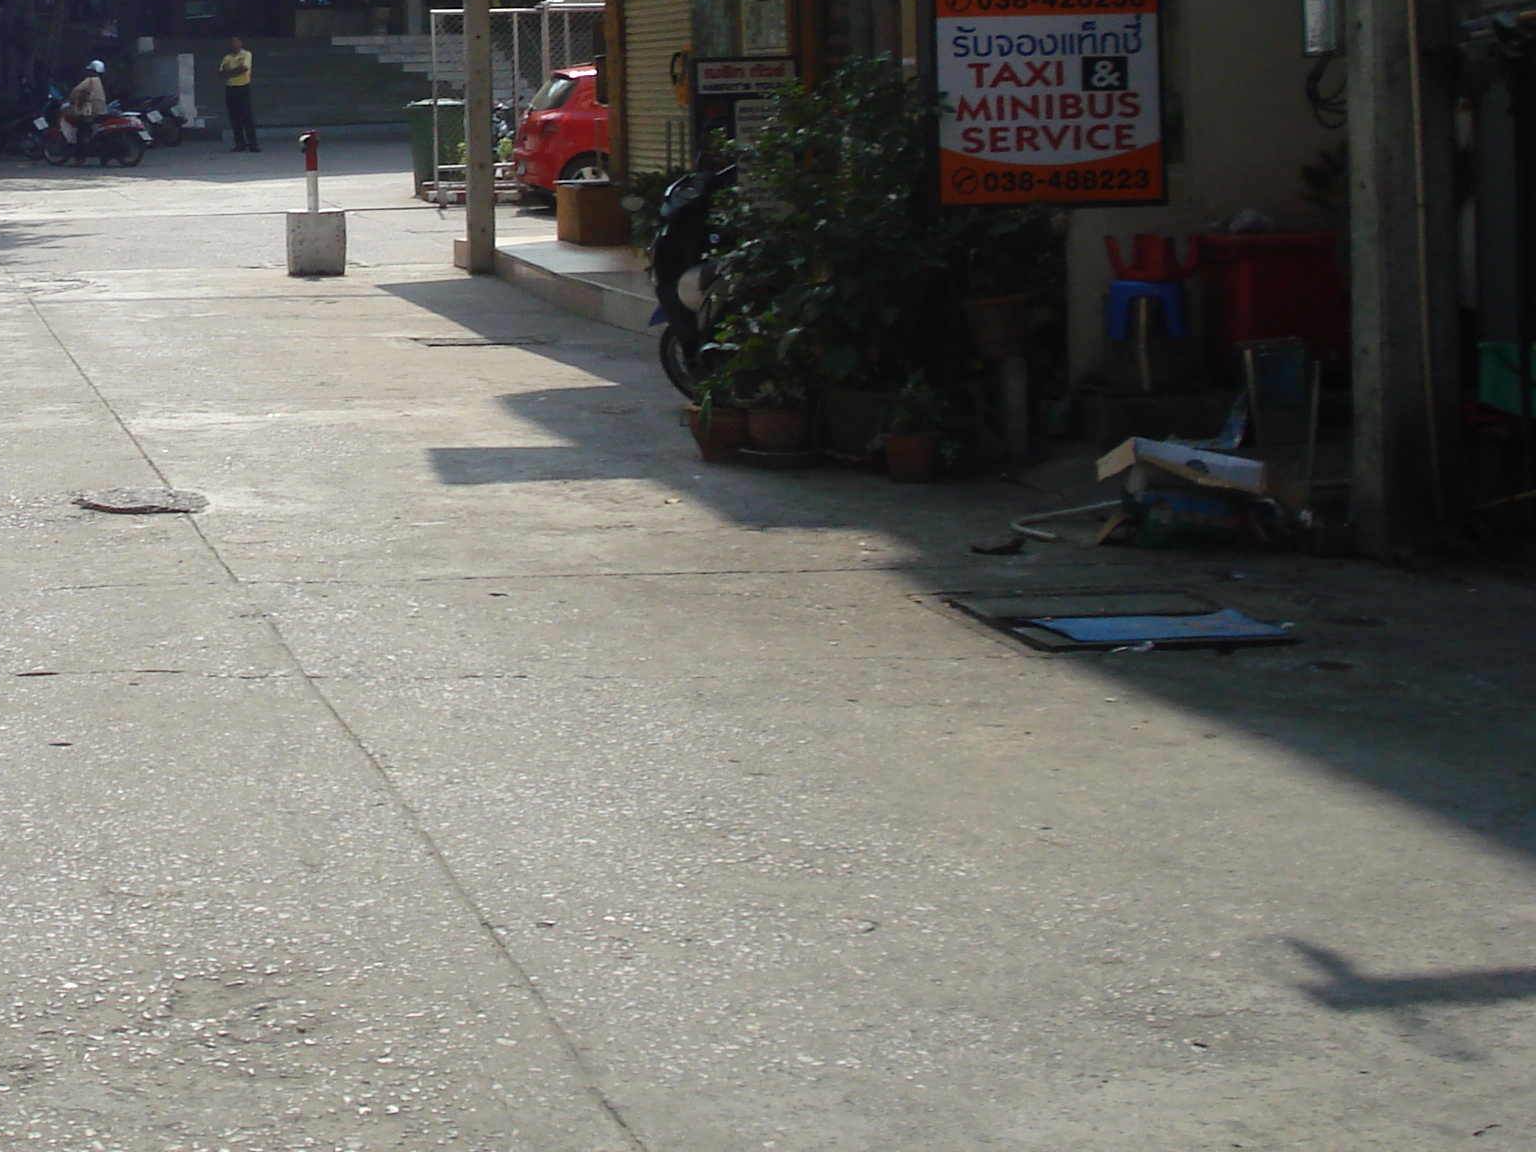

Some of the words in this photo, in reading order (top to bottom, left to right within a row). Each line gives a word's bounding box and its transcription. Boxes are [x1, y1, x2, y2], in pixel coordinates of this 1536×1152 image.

[967, 61, 1064, 90] TAXI
[1090, 59, 1121, 88] &
[955, 91, 1141, 123] MINIBUS
[961, 124, 1137, 155] SERVICE
[983, 168, 1150, 193] 038-488223
